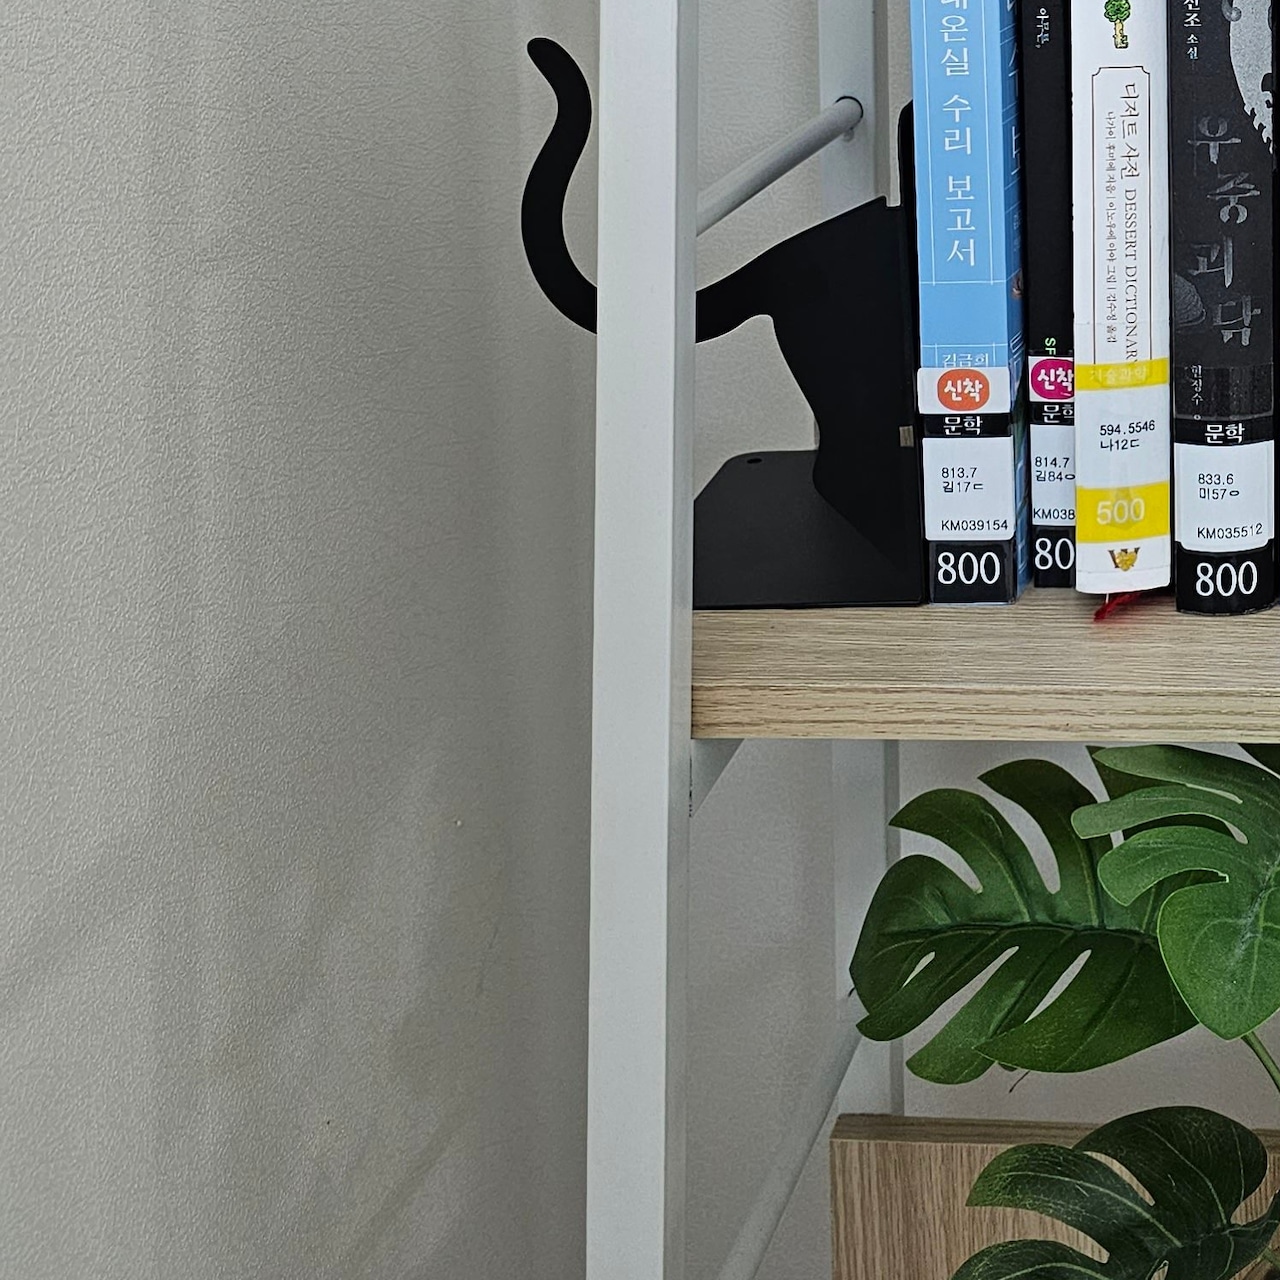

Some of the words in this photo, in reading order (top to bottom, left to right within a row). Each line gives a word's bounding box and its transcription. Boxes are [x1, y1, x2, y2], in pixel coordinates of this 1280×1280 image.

[1186, 33, 1199, 60] 소설
[1120, 83, 1140, 139] 디저트
[942, 94, 972, 155] 수리
[1105, 111, 1116, 140] 나가이
[1120, 142, 1140, 180] 사전
[1105, 175, 1117, 194] 지음
[945, 175, 976, 267] 보고서
[1125, 189, 1137, 260] DESSERT
[1106, 243, 1117, 262] 아야
[1126, 265, 1138, 362] DICTIONAR
[942, 353, 989, 367] 김금희
[943, 377, 984, 403] 신착
[1037, 367, 1074, 392] 신착
[943, 416, 983, 436] 문학
[1099, 420, 1156, 436] 594.5546
[1204, 423, 1246, 444] 문학
[941, 467, 978, 479] 813.7
[1035, 456, 1070, 468] 814.7
[1198, 473, 1235, 486] 833.6
[1096, 497, 1146, 525] 500
[941, 520, 1009, 532] KM039154
[1197, 523, 1263, 540] KM035512
[937, 551, 1001, 585] 800
[1195, 561, 1258, 597] 800
